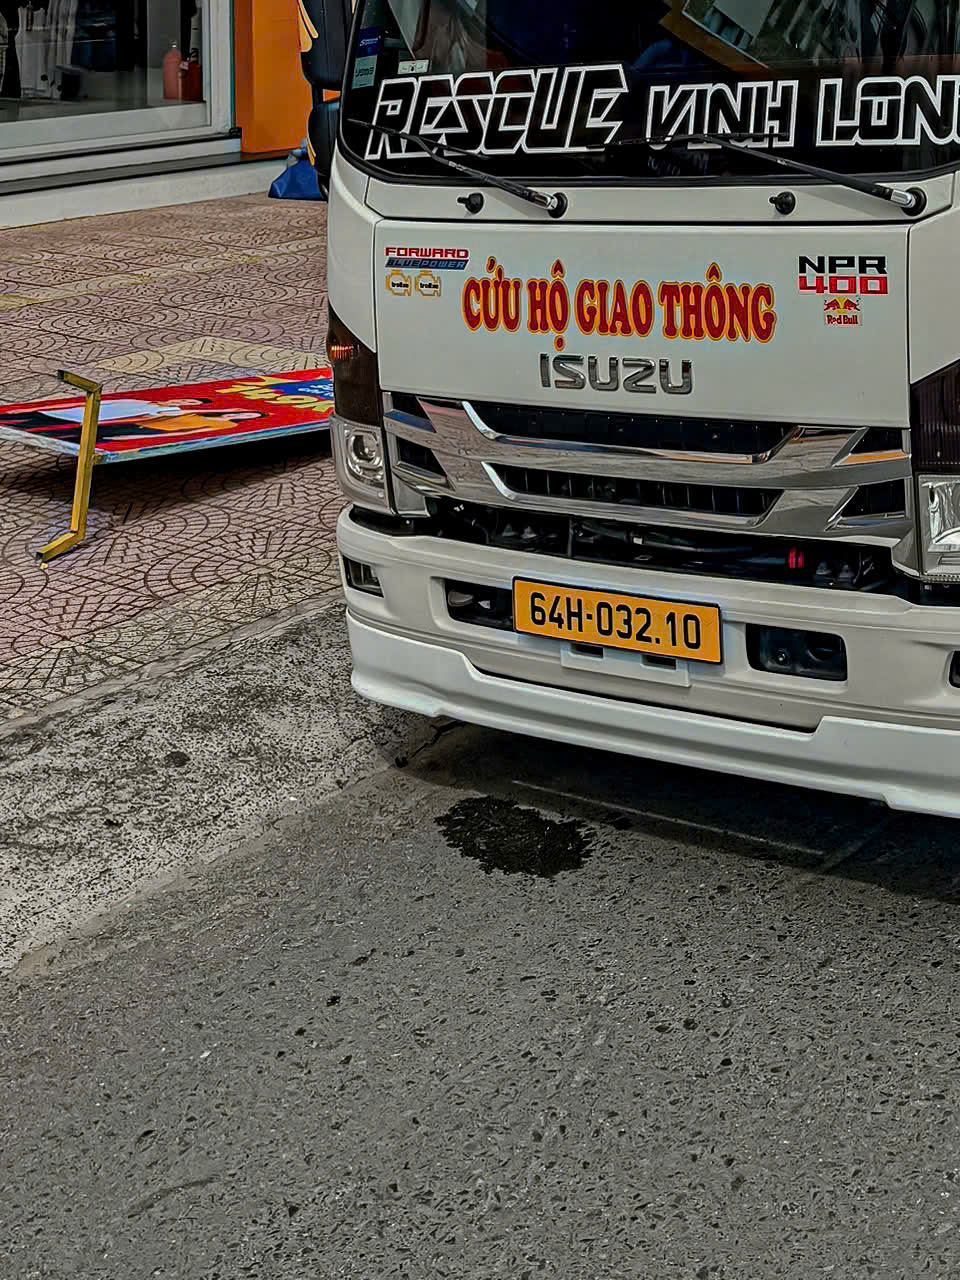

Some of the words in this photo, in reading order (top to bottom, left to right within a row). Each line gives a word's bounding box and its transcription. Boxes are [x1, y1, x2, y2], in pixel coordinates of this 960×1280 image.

[364, 63, 629, 161] RESCUE
[645, 79, 800, 151] VINH
[385, 247, 469, 259] FORWARD
[386, 258, 467, 270] BLUEPOWER
[799, 256, 888, 274] NPR
[799, 276, 888, 294] 400
[462, 256, 522, 332] CỨU
[526, 258, 571, 352] HỘ
[574, 278, 654, 337] GIAO
[658, 261, 776, 343] THÔNG
[826, 315, 842, 325] Red
[843, 314, 859, 325] Bull
[539, 352, 694, 395] ISUZU
[530, 592, 701, 650] 64H-032.10
